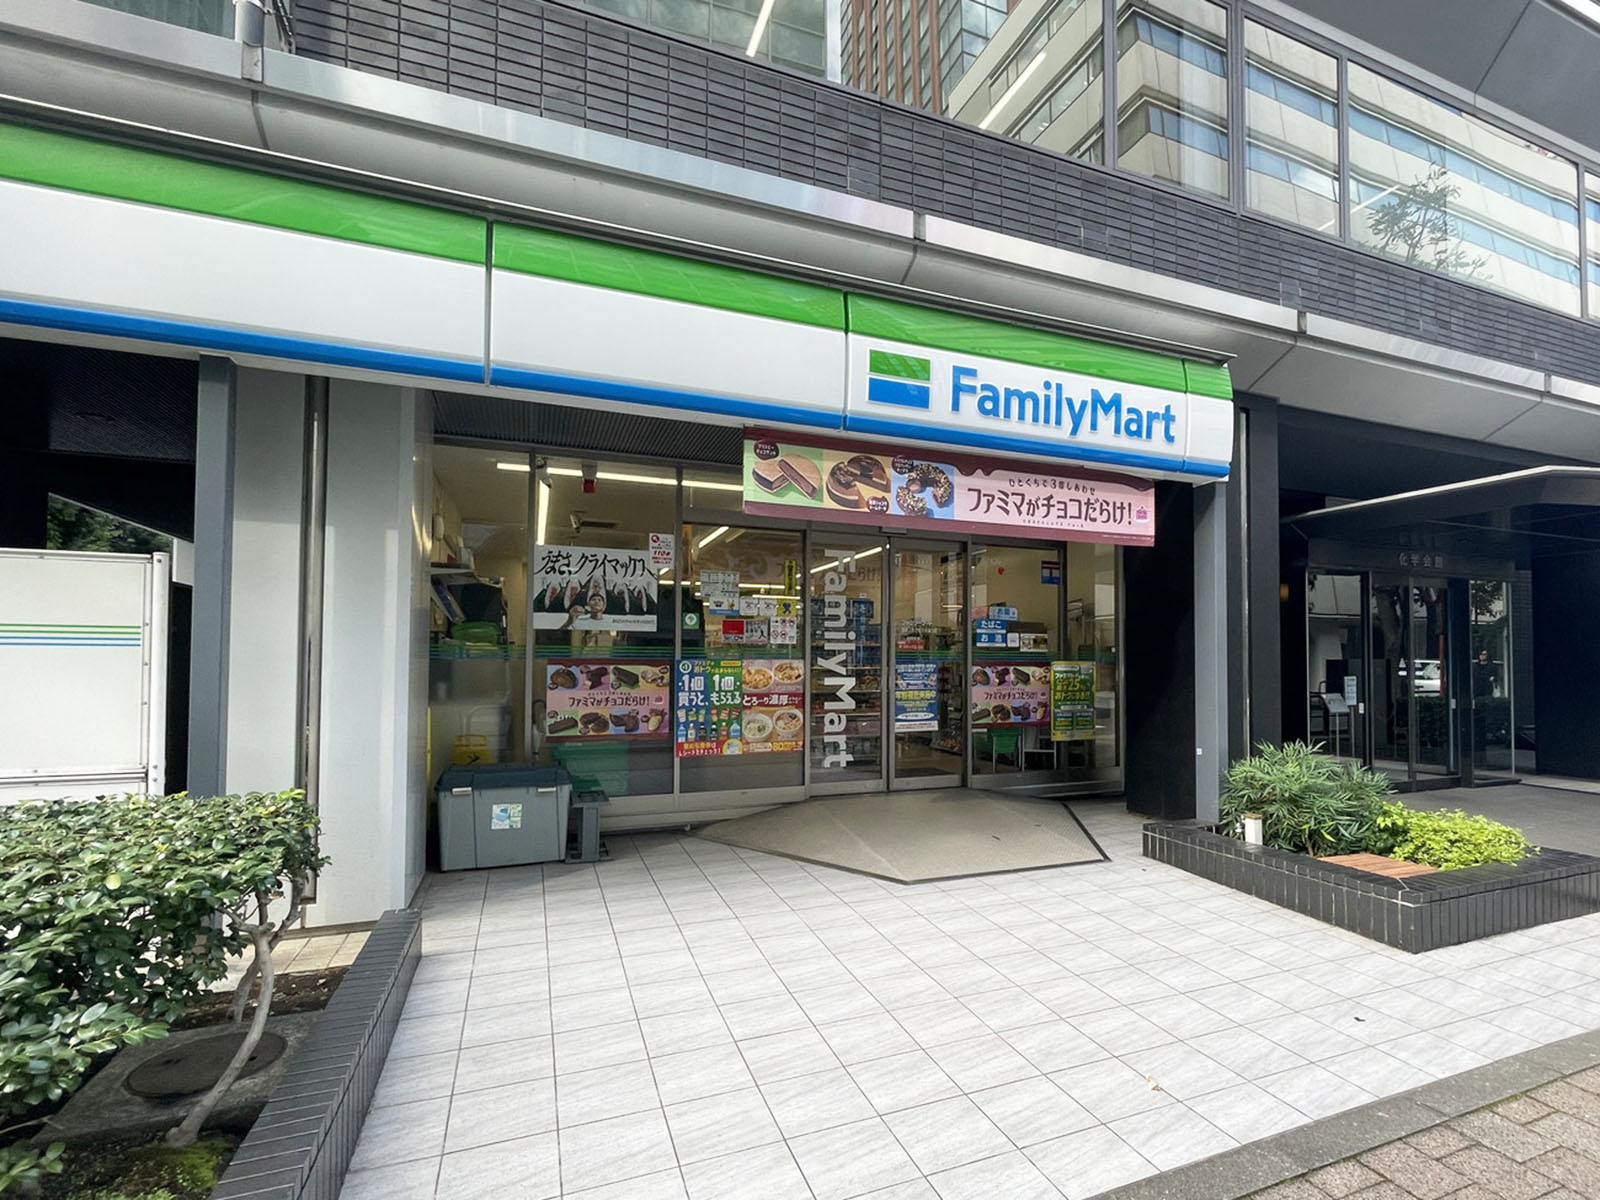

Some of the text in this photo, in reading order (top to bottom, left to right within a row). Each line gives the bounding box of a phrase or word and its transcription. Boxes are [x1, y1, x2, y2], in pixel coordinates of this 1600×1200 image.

[951, 364, 1177, 444] FamilyMart
[967, 487, 1132, 526] ファミマがチョコだらけ！
[980, 620, 1002, 629] たばこ
[817, 549, 856, 768] FamilyMart
[710, 692, 741, 706] もらえる
